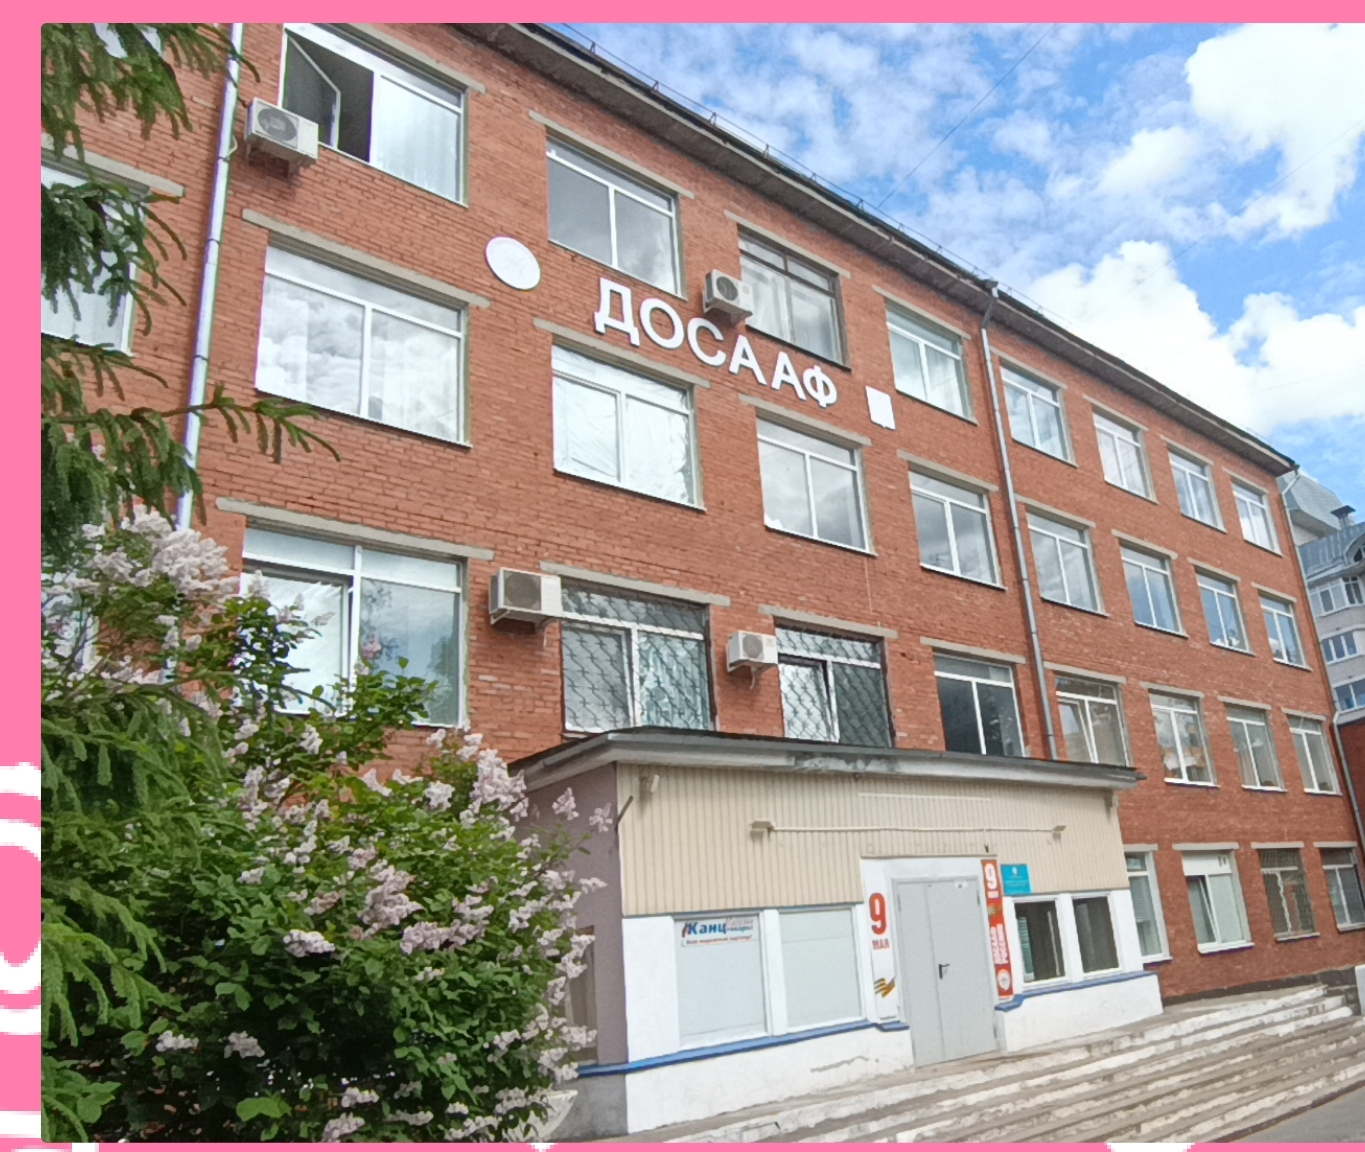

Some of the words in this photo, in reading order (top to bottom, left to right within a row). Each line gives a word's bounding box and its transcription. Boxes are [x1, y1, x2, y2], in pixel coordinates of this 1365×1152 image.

[594, 277, 838, 407] ДОСААФ
[985, 863, 997, 890] 9
[869, 893, 887, 935] 9
[686, 921, 727, 935] Канц
[872, 939, 890, 950] МАЯ
